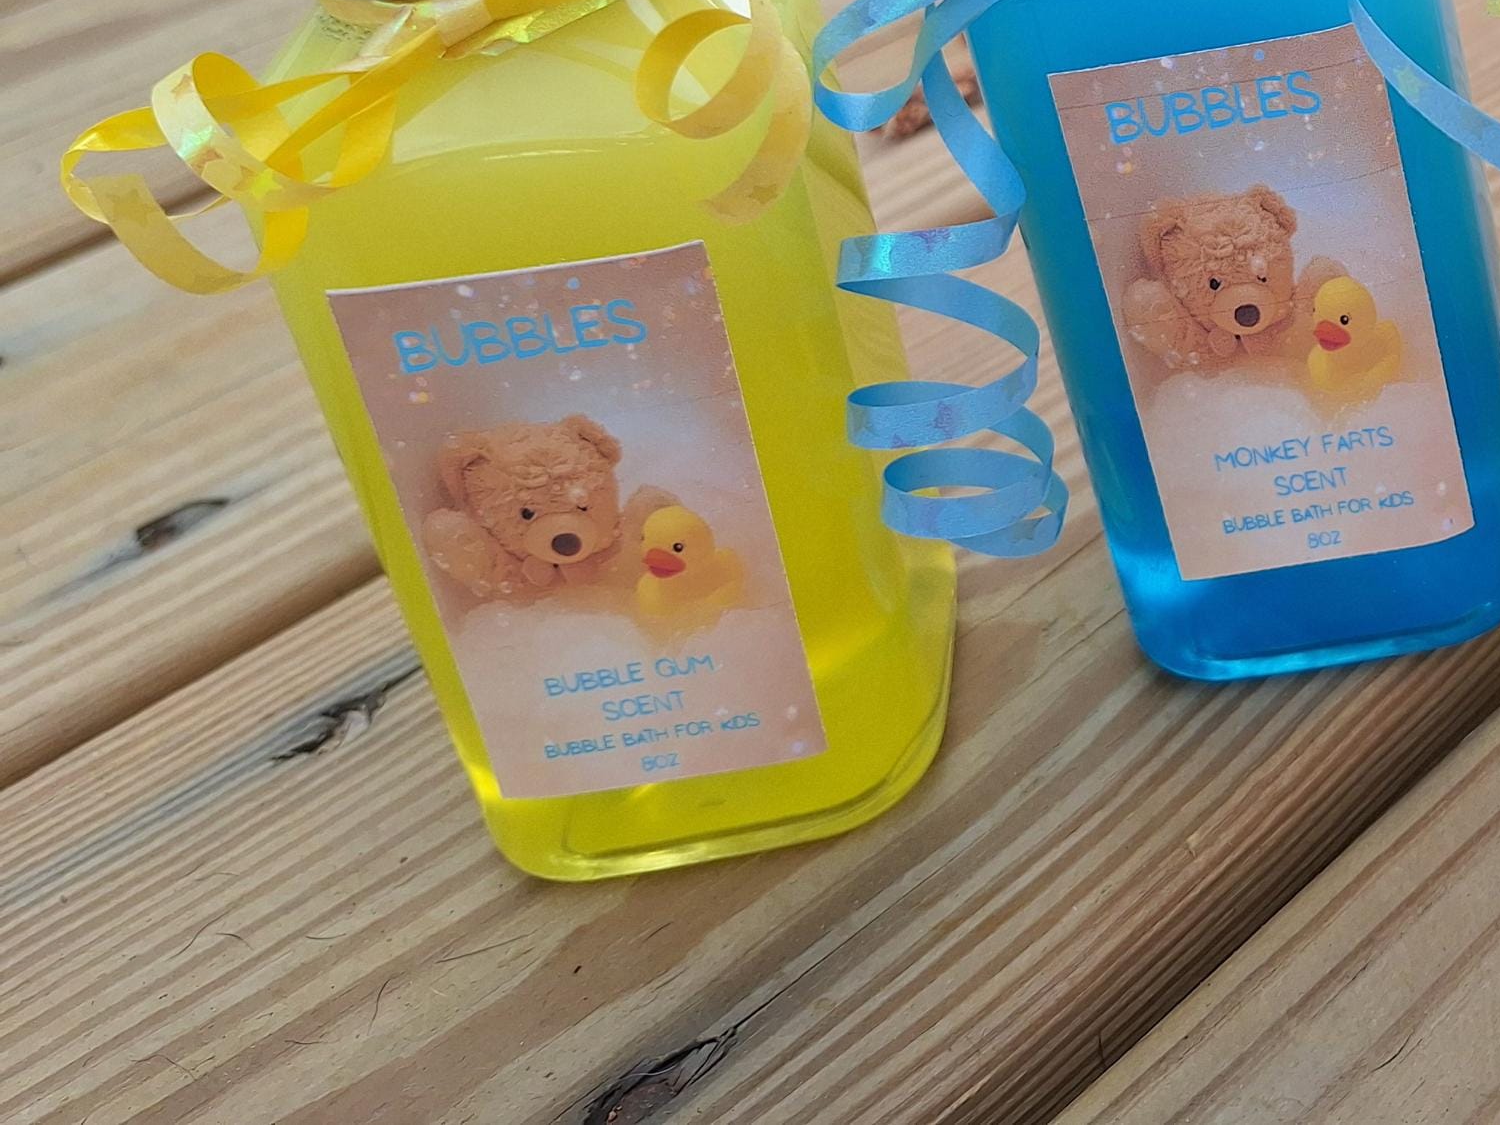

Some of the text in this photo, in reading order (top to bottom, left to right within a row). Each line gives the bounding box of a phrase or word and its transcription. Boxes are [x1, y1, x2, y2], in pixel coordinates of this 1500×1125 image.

[1106, 71, 1322, 144] BUBBLES
[393, 299, 648, 374] BUBBLES
[1214, 426, 1394, 471] MONKEY FARTS
[1274, 467, 1347, 496] SCENT
[1222, 510, 1285, 534] BUBBLE
[1291, 504, 1333, 523] BATH
[1338, 498, 1372, 515] FOR
[544, 655, 715, 696] BUBBLE GUM
[602, 691, 684, 721] SCENT
[545, 734, 616, 758] BUBBLE
[622, 728, 669, 748] BATH
[675, 721, 714, 738] FOR
